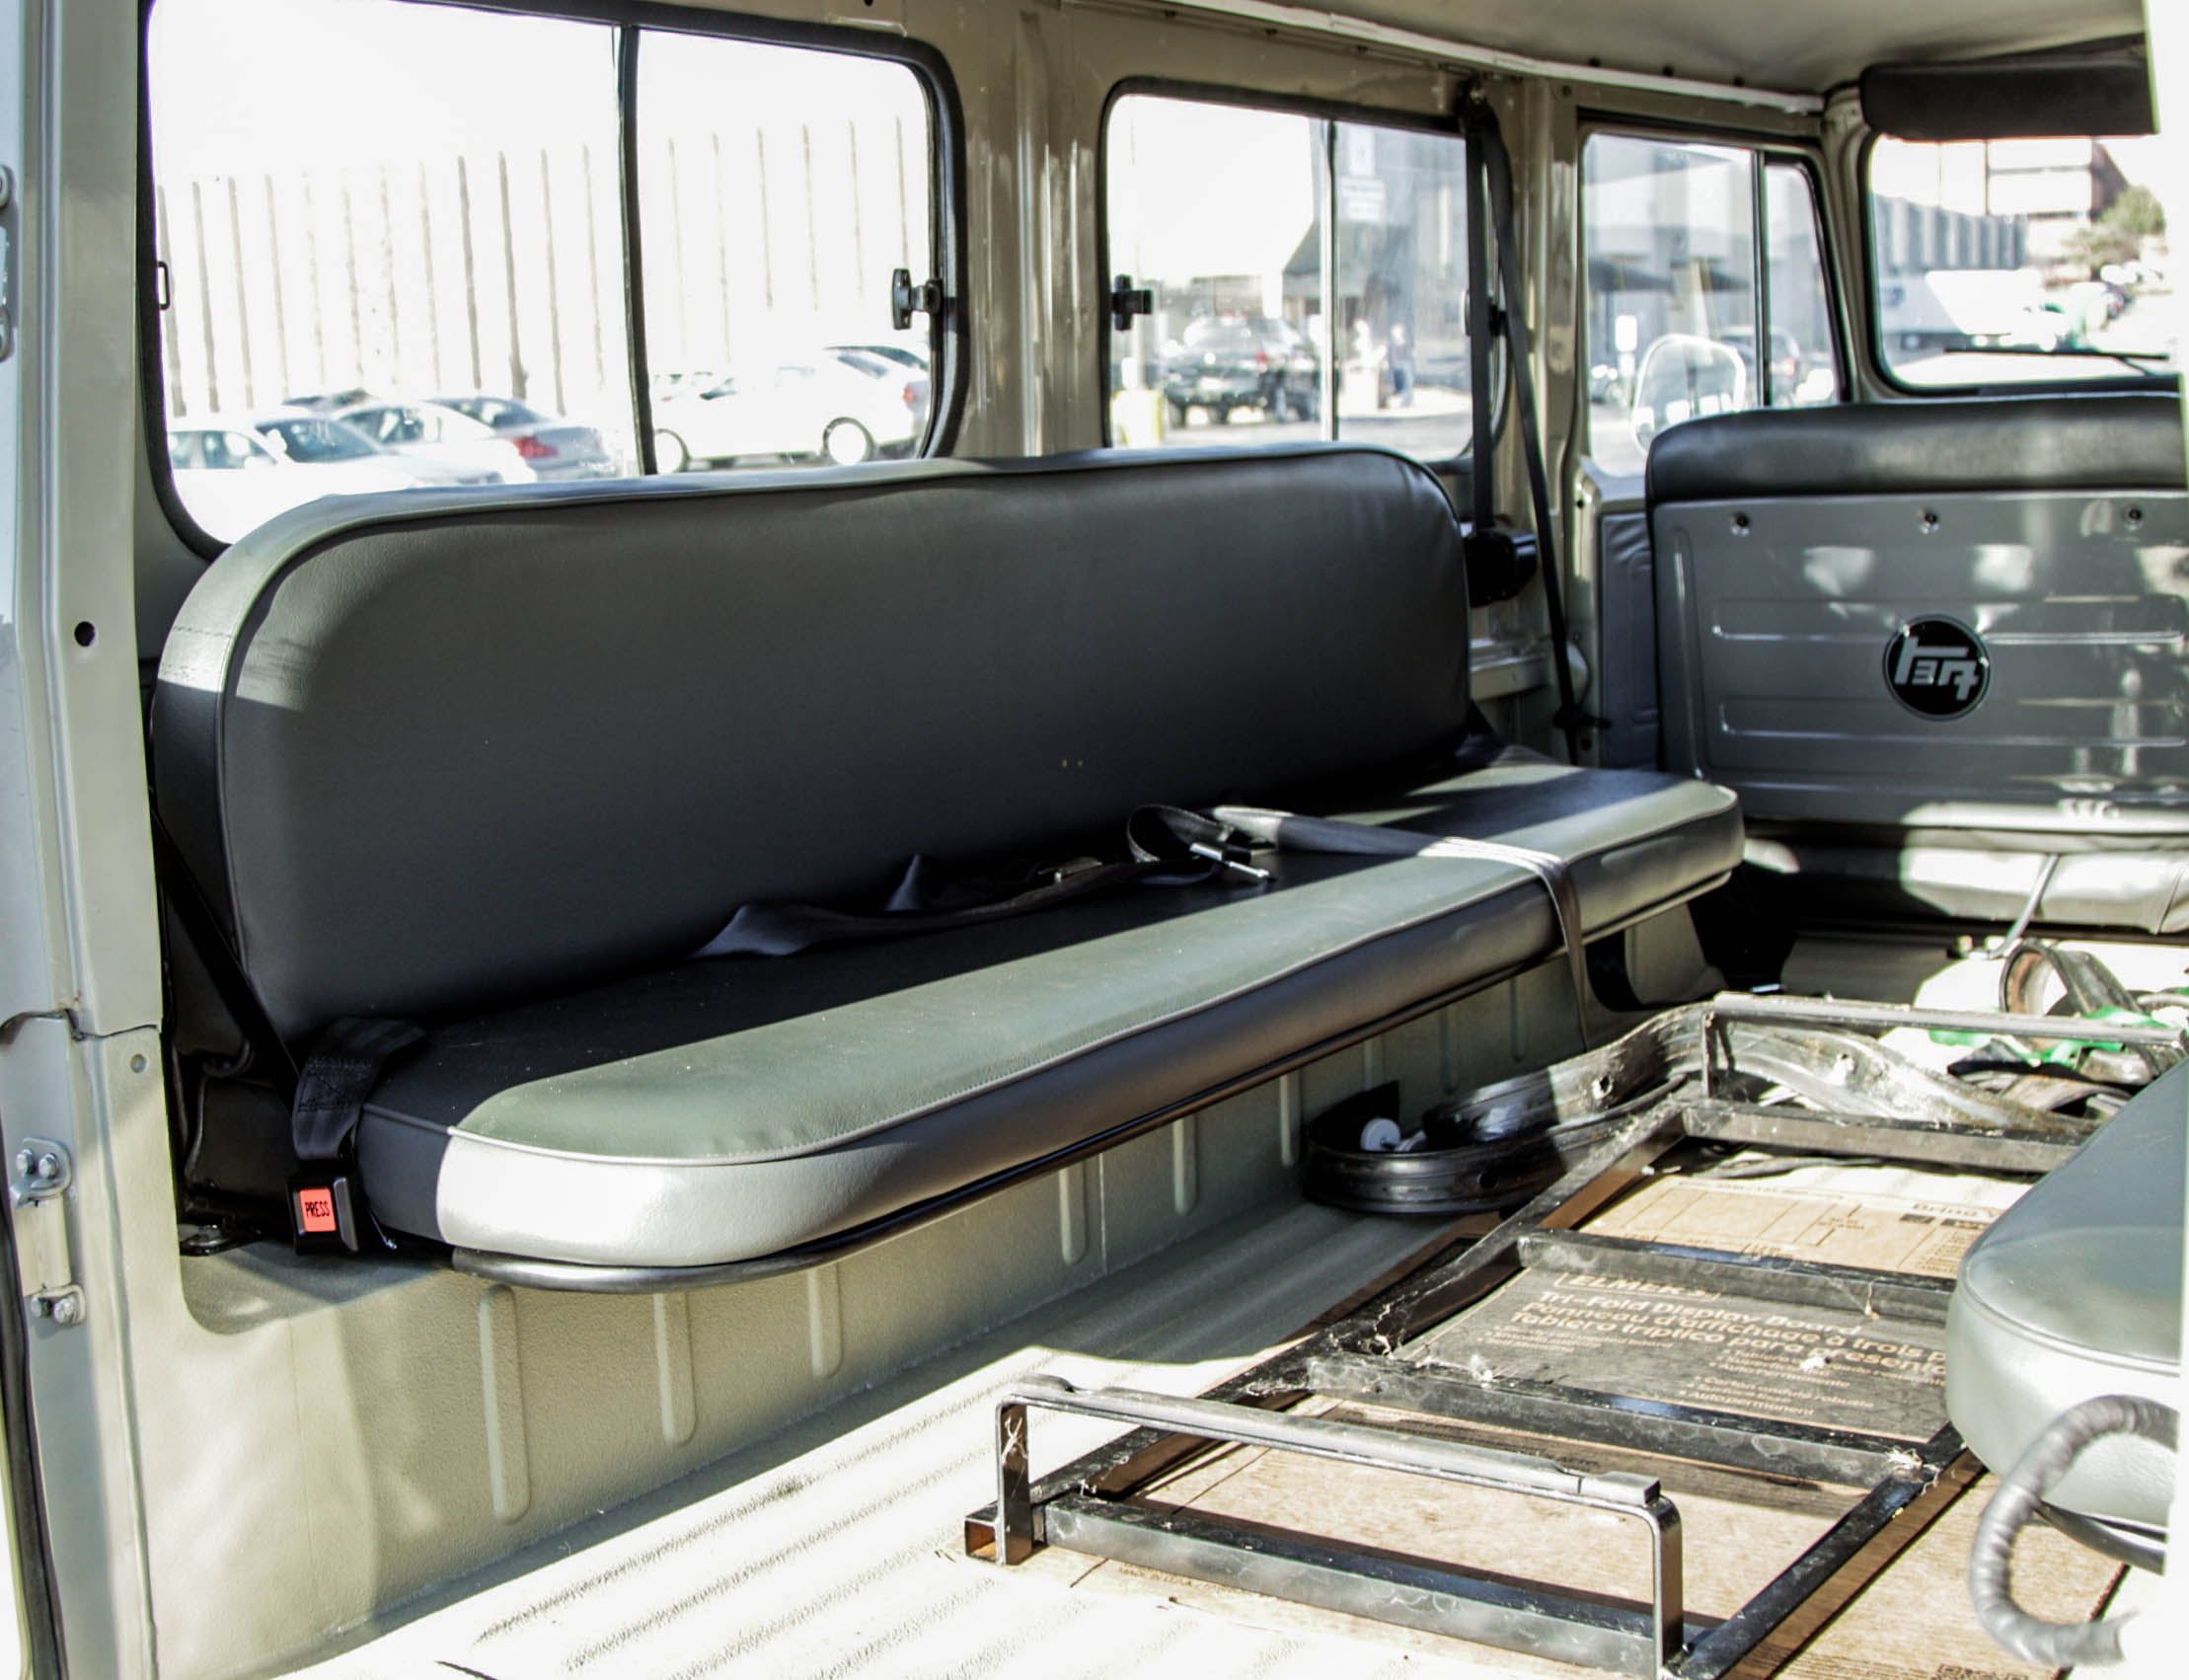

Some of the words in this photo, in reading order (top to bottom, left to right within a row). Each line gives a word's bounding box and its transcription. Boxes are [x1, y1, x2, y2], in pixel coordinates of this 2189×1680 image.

[304, 1200, 331, 1217] PRESS
[1569, 1274, 1706, 1296] ELMERS
[1511, 1311, 1617, 1332] Tablero
[1726, 1336, 1805, 1353] para
[1522, 1301, 1649, 1323] Panneau
[1653, 1315, 1821, 1342] d'affichage
[1825, 1334, 1848, 1346] à
[1851, 1337, 1925, 1358] trois
[1540, 1291, 1650, 1311] Tri-Fold
[1651, 1302, 1762, 1324] Display
[1765, 1315, 1862, 1335] Board
